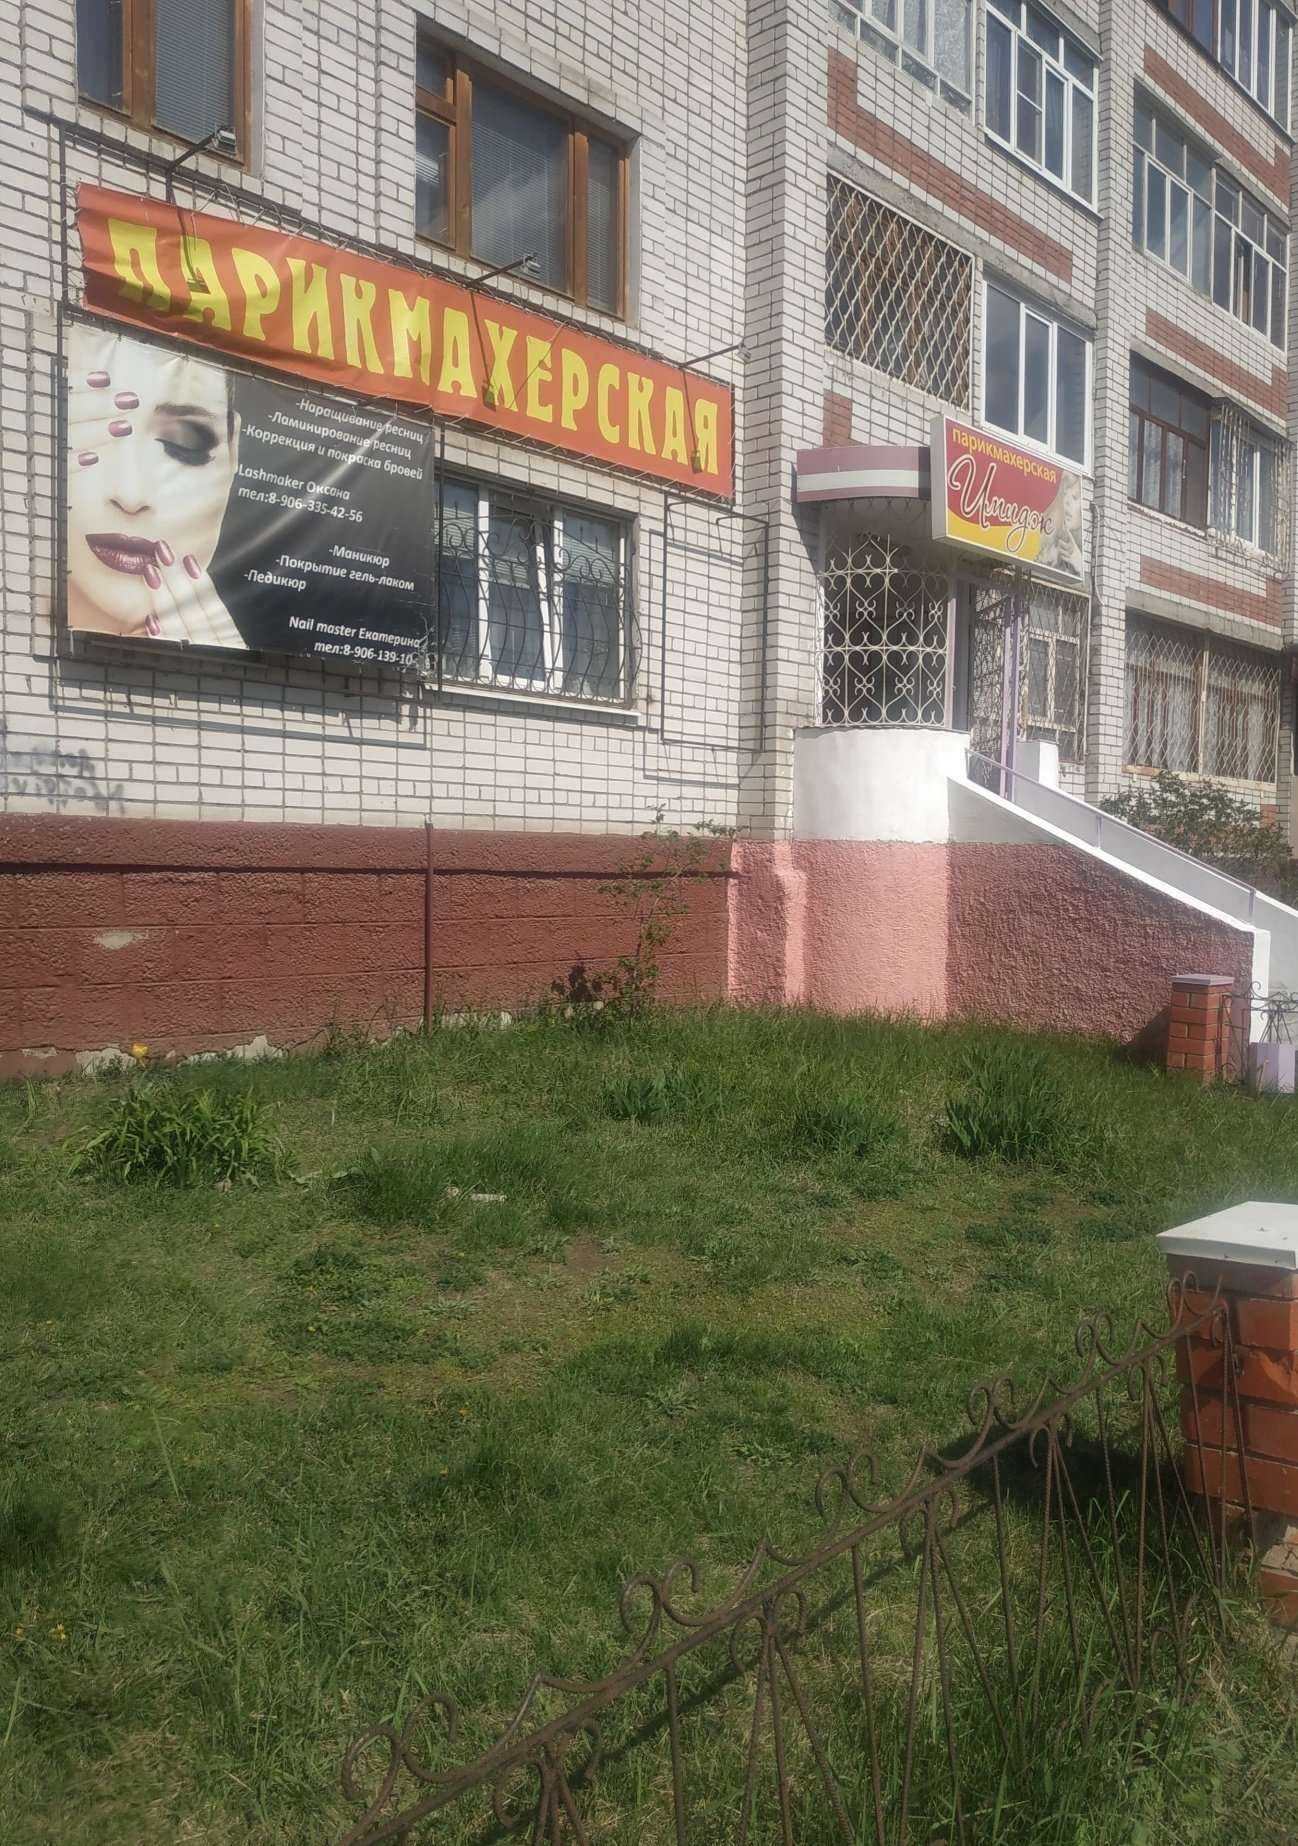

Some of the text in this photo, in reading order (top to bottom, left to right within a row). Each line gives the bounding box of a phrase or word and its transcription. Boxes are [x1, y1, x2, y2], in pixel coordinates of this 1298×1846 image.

[107, 218, 719, 475] ПАРИКМАХЕРСКАЯ
[267, 411, 412, 460] -Ламинирование ресниц
[296, 398, 424, 444] -Наращивание ресниц
[241, 424, 315, 452] -Коррекция
[327, 448, 381, 468] покраска
[383, 459, 423, 480] бровей
[952, 428, 1057, 483] парикмахерская
[238, 464, 351, 500] Lashmaker Оксана
[238, 485, 363, 523] тел:8-906-335-42-56
[948, 454, 1056, 553] Имидж
[275, 554, 415, 591] -Покрытие гель-лаком
[328, 545, 390, 569] -Маникюр
[243, 569, 307, 592] -Педикюр
[289, 616, 421, 648] Nail master Екатерина
